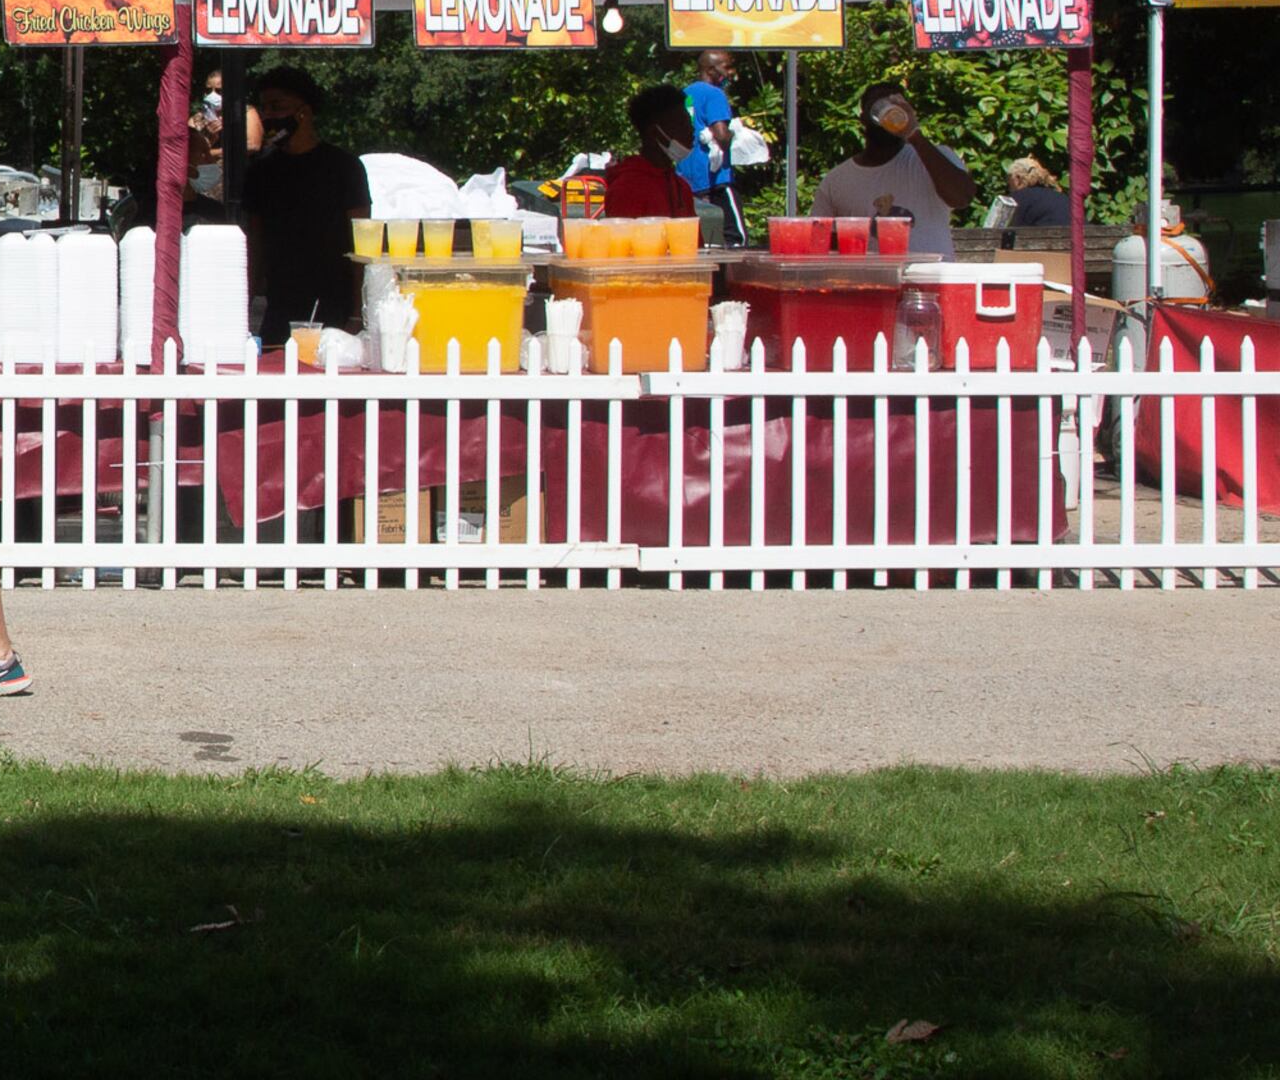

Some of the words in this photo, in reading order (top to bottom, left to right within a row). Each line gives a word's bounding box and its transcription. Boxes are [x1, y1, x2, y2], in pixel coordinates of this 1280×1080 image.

[12, 6, 57, 33] Fried
[58, 6, 115, 32] Chicken
[118, 7, 171, 36] Wings
